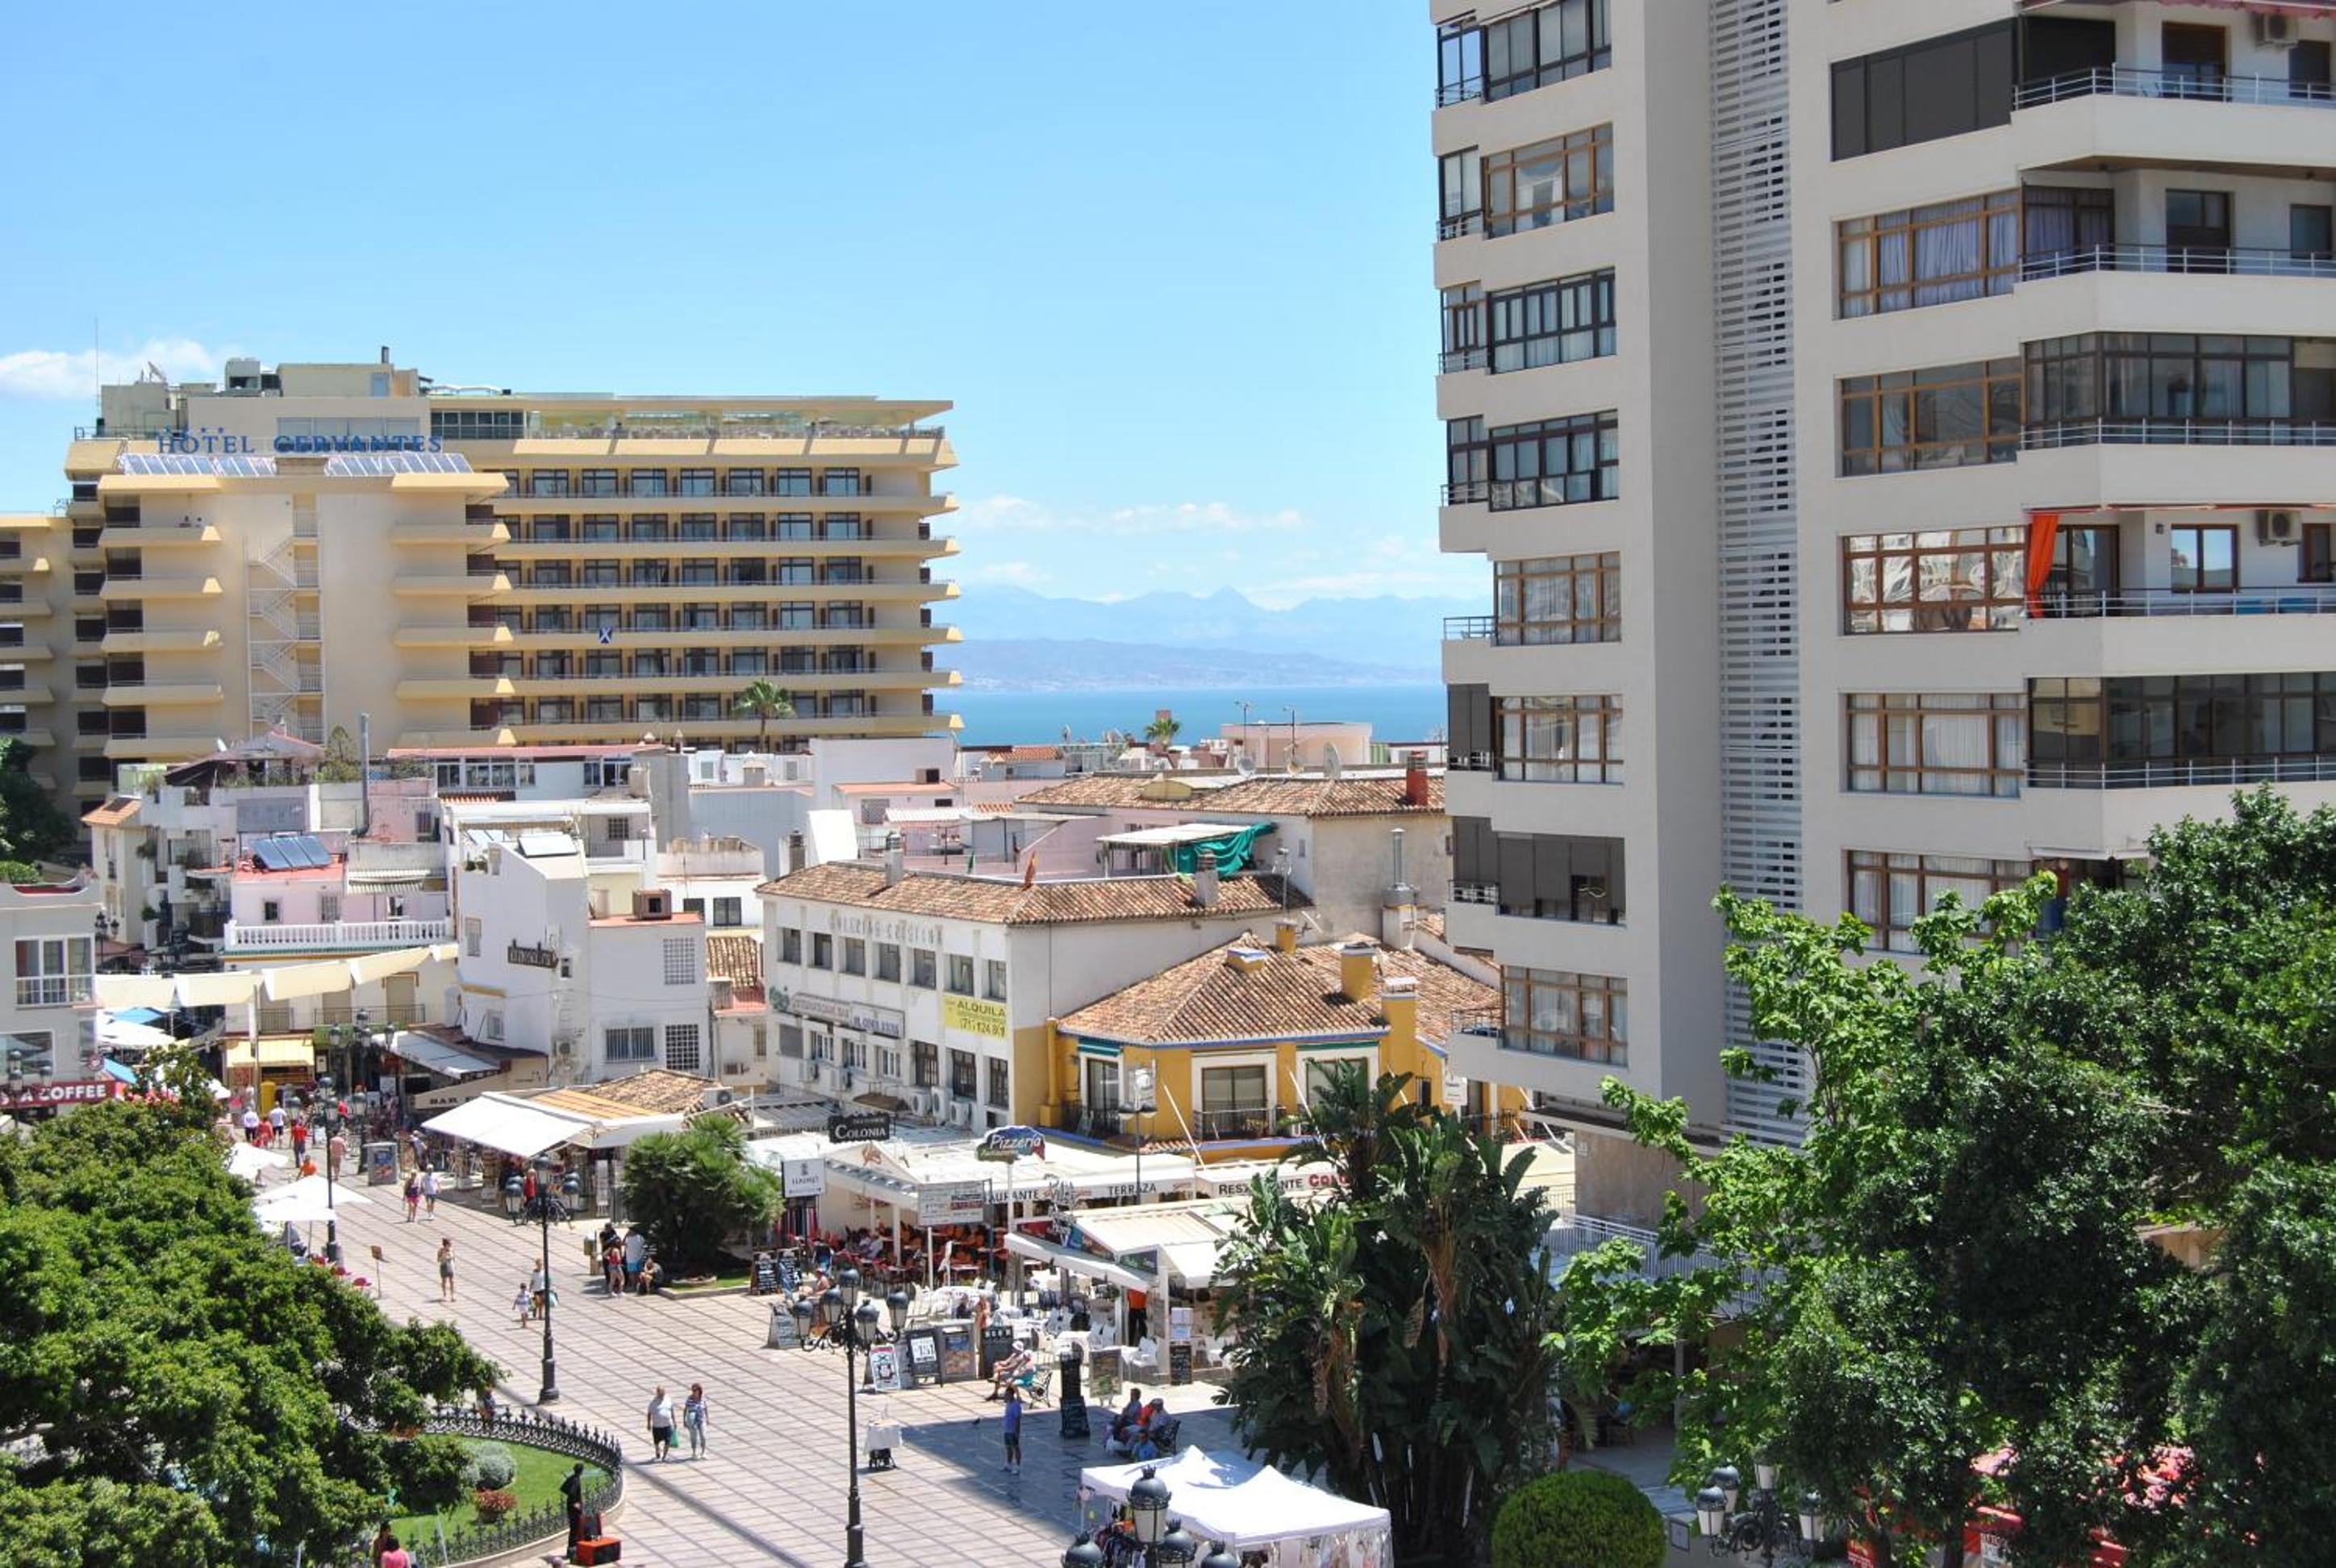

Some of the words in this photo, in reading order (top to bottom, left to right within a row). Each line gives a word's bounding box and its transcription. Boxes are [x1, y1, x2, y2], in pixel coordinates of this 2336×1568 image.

[157, 436, 255, 453] HOTEL
[274, 435, 442, 452] CERVANTES
[957, 1000, 1005, 1016] ALQUILA
[39, 1084, 106, 1100] COFFEE
[1108, 1183, 1156, 1195] TERRAZA
